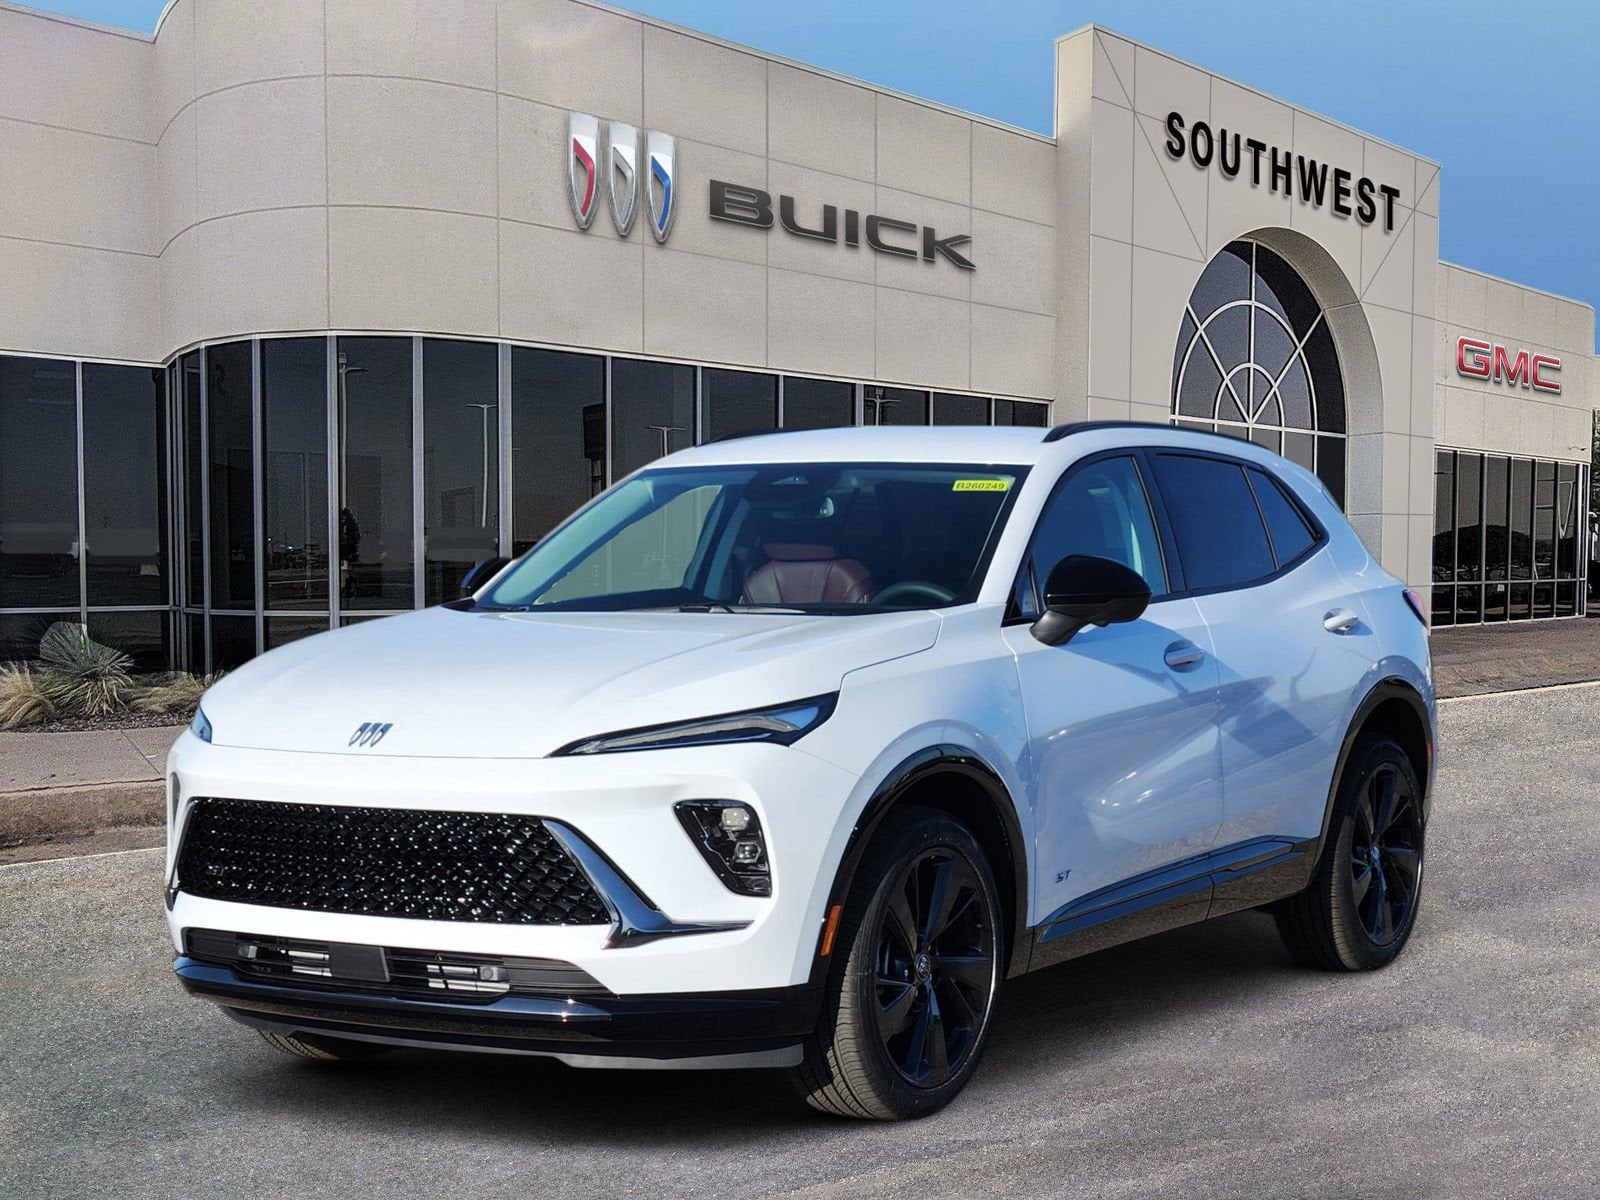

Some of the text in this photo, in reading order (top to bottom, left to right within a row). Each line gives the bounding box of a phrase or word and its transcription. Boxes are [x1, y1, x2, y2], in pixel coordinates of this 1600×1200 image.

[1165, 111, 1400, 232] SOUTHWEST
[709, 179, 976, 270] BUICK
[1457, 336, 1561, 393] GMC
[956, 481, 1005, 490] B260249
[1055, 869, 1072, 883] ST
